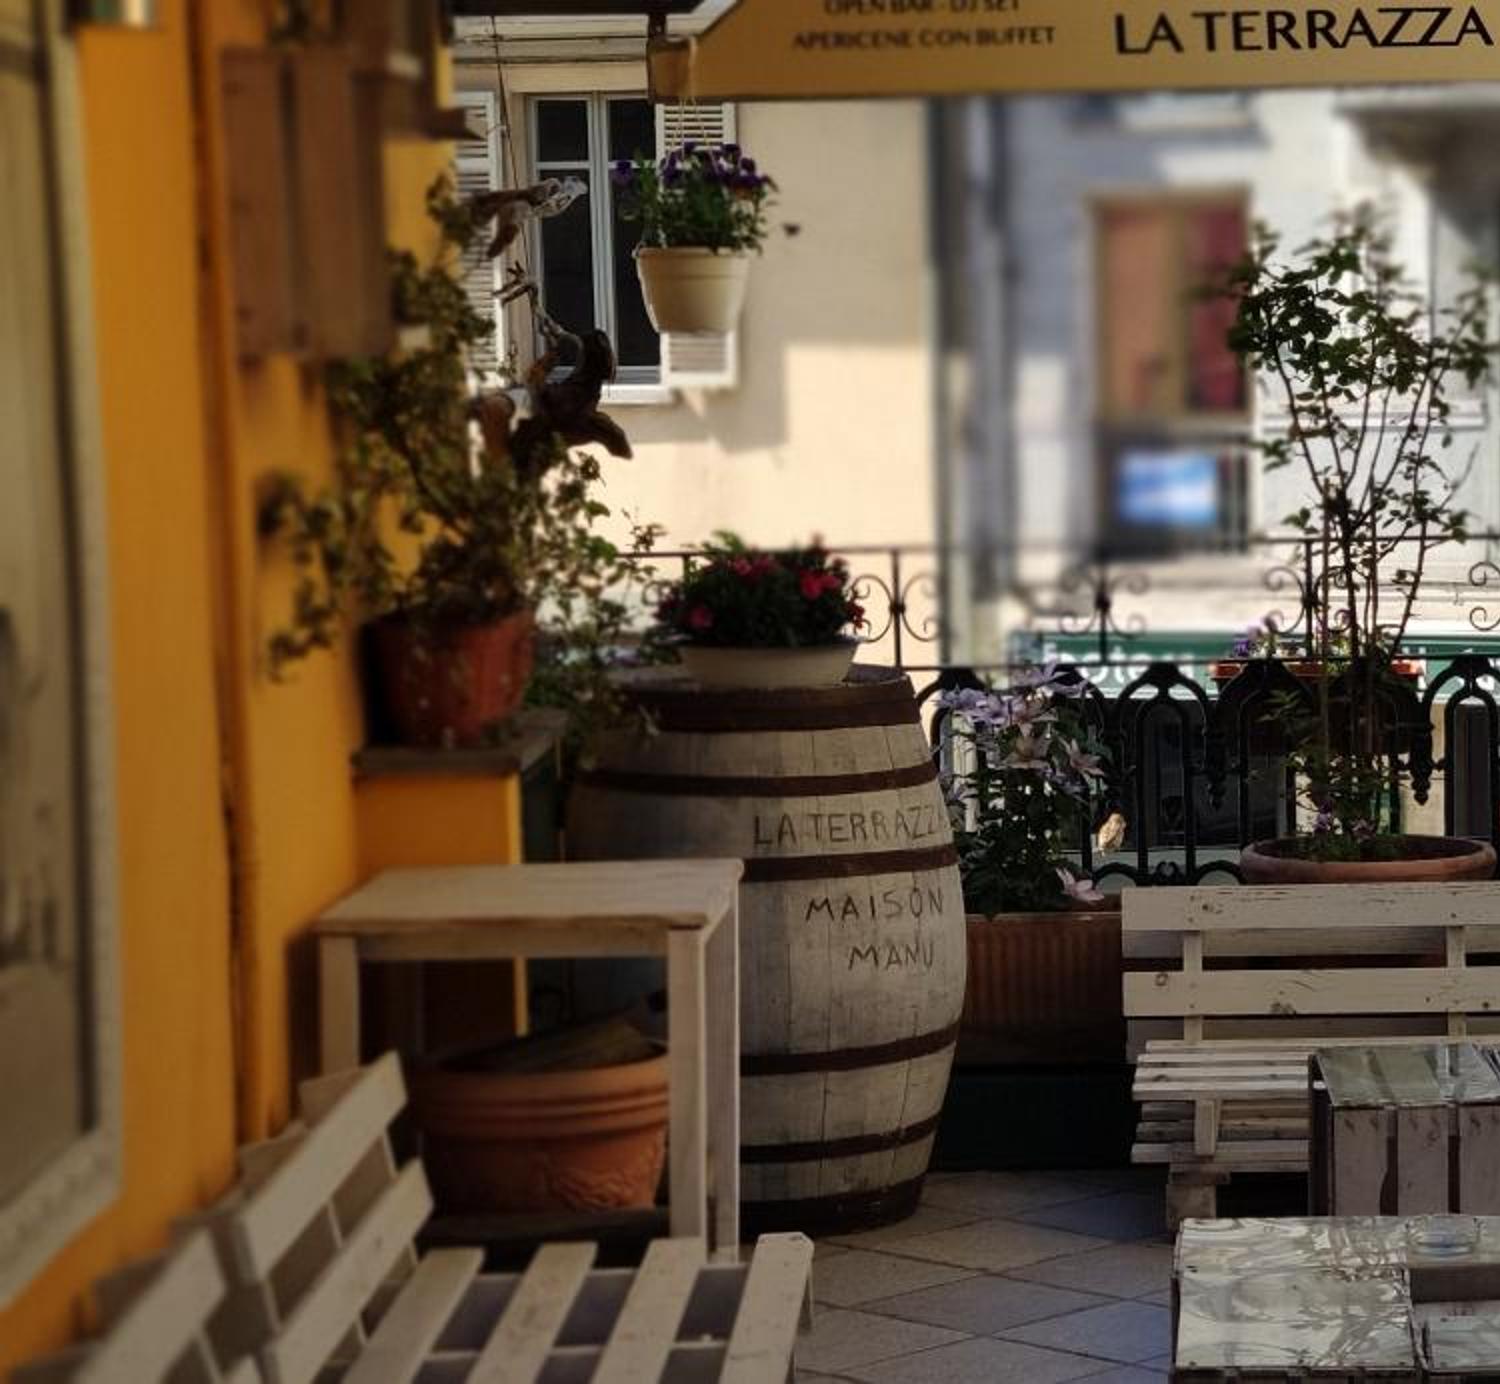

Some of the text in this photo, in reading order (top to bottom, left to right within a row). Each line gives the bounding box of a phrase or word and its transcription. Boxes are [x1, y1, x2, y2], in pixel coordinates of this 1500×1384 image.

[793, 26, 1056, 49] APERICENE CON BUFFET
[1115, 6, 1494, 54] LA TERRAZZA
[753, 812, 797, 847] LA
[805, 887, 943, 921] MAISON
[848, 940, 934, 971] MANU
